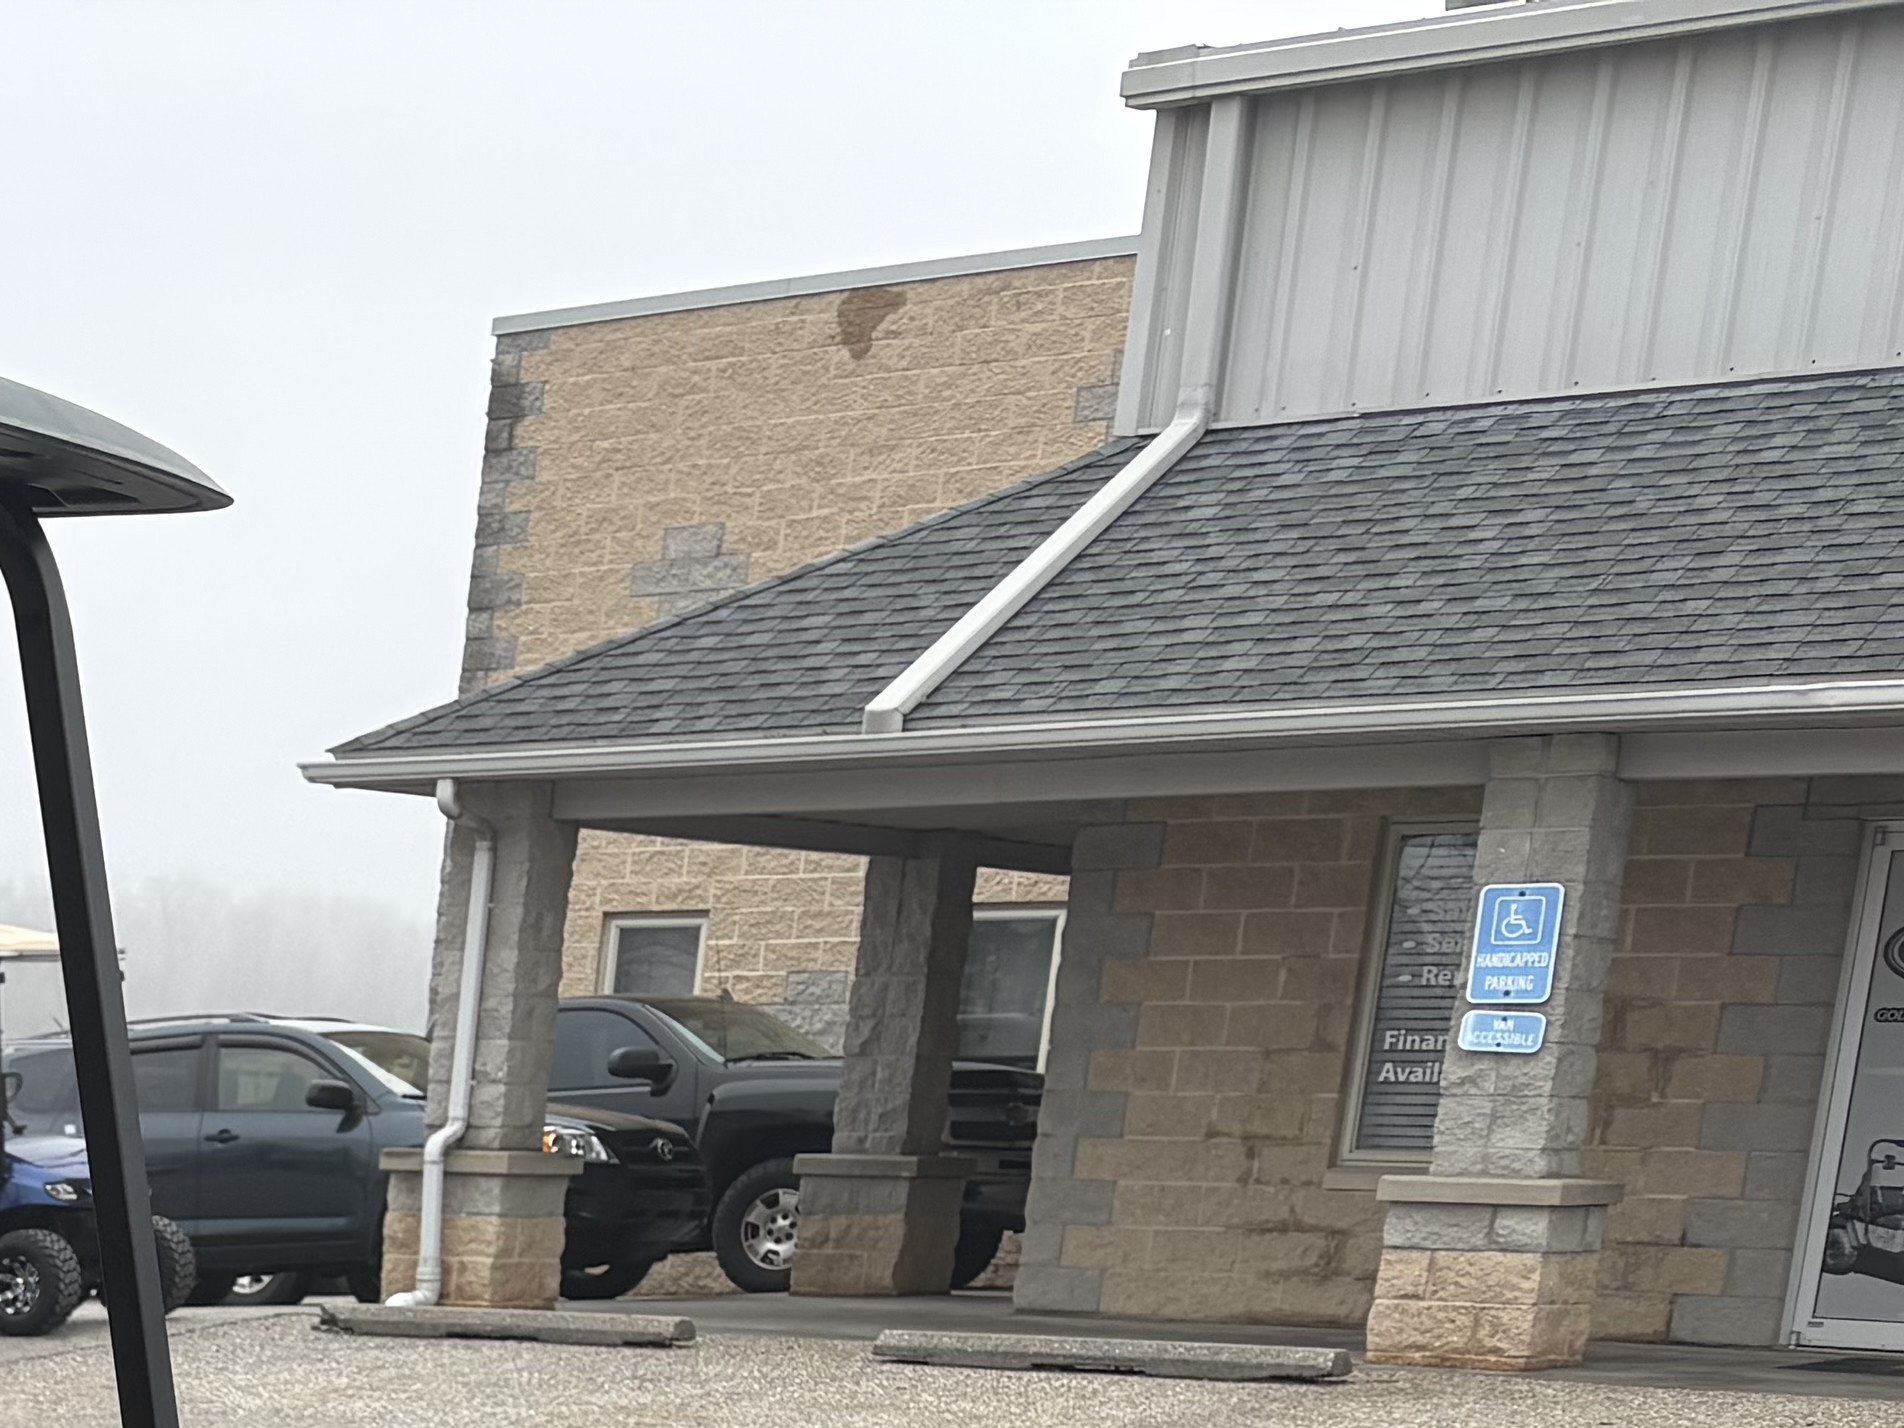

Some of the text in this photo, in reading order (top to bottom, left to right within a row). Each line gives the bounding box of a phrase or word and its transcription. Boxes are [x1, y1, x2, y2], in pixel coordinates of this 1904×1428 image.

[1476, 952, 1549, 968] HANDICAPPED
[1484, 975, 1535, 991] PARKING
[1493, 1019, 1515, 1031] VAN
